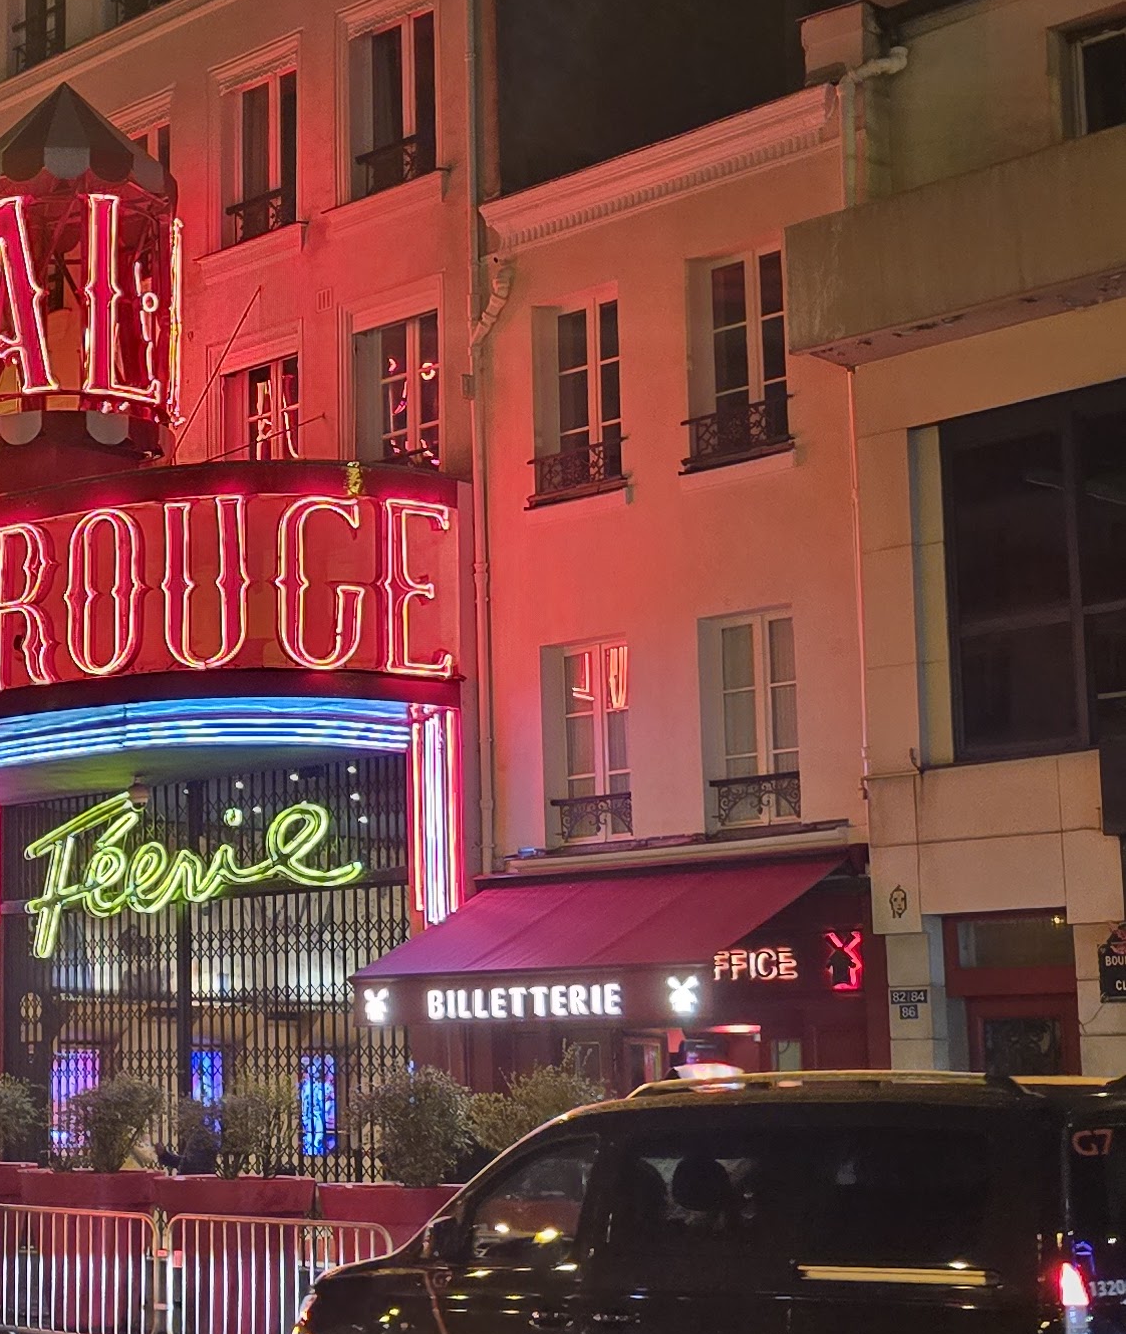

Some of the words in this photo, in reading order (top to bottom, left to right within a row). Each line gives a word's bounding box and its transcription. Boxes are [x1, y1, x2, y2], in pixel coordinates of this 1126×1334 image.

[714, 947, 799, 981] FFICE
[427, 982, 623, 1021] BILLETTERIE
[901, 1006, 916, 1017] 86
[1072, 1128, 1114, 1156] G7
[1088, 1279, 1126, 1297] 1320
